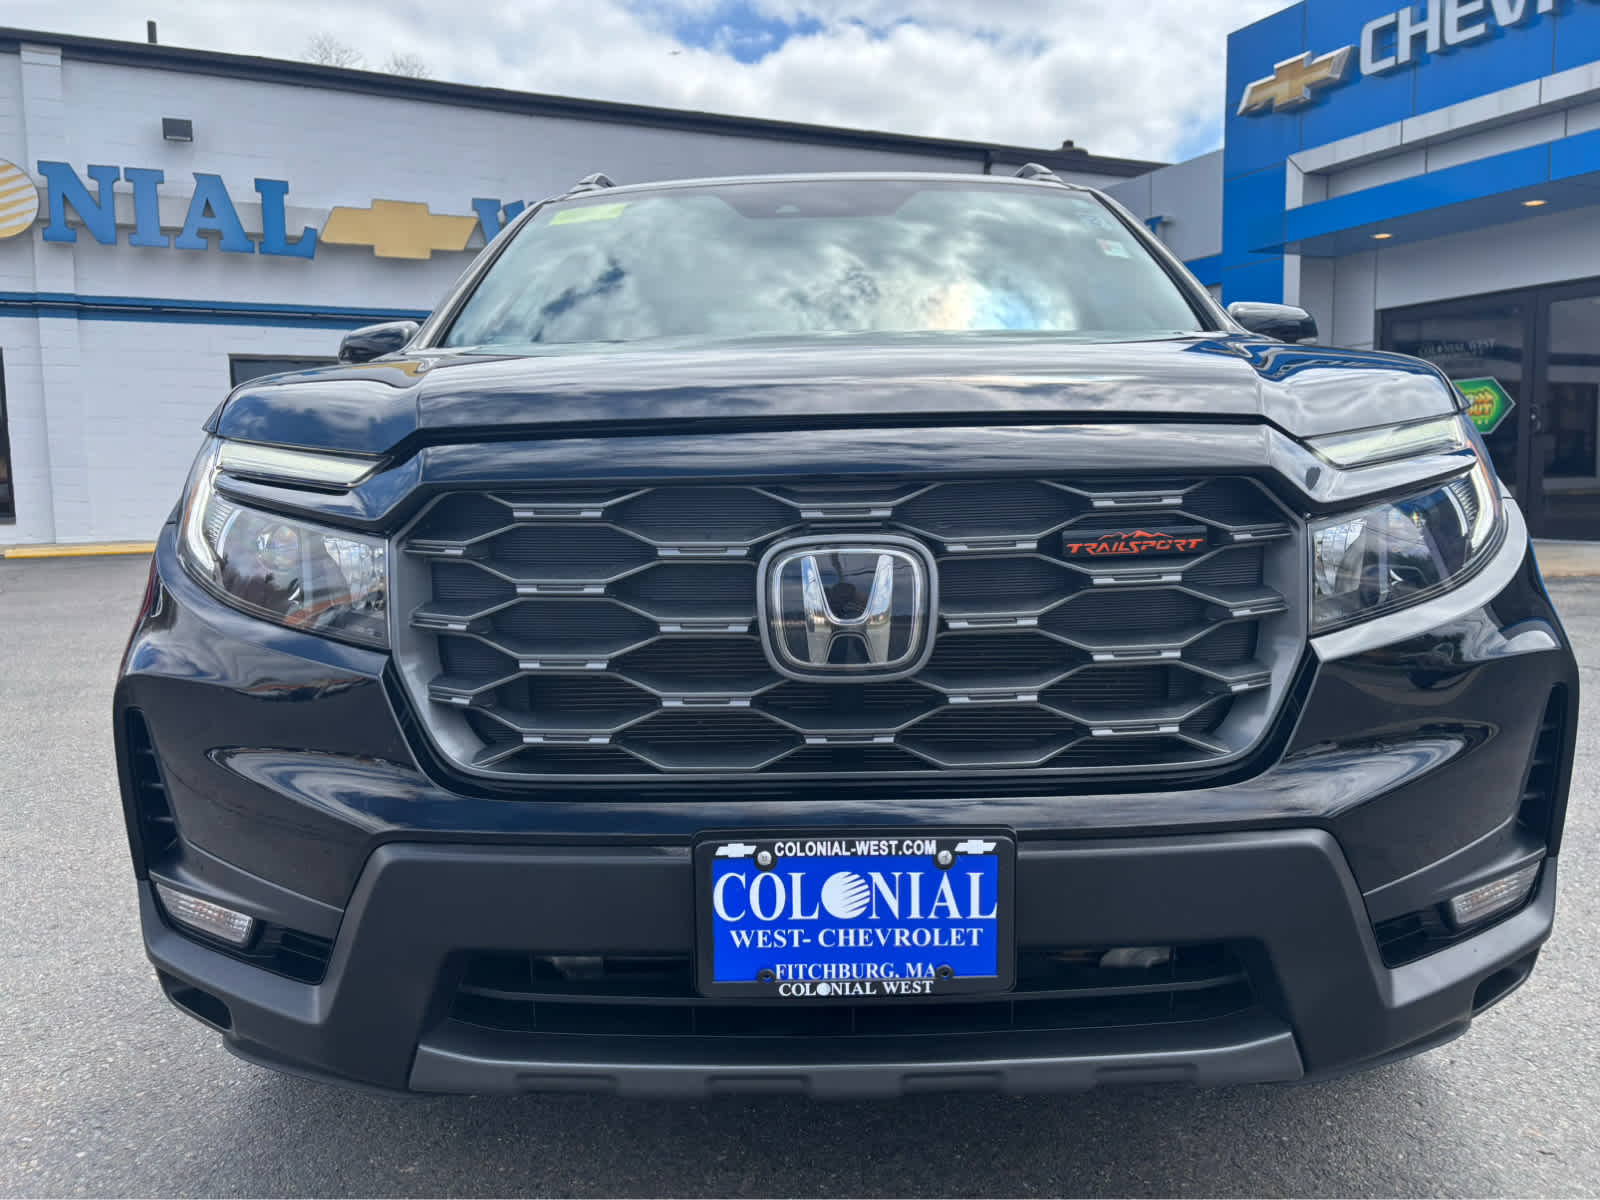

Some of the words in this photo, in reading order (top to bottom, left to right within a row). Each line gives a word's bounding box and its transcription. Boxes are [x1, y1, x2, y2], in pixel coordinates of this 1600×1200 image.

[1360, 0, 1553, 76] CHE
[1066, 538, 1204, 555] TRAILSPORT
[774, 839, 937, 857] COLONIAL-WEST.COM
[712, 871, 998, 922] COLONIAL
[730, 929, 811, 948] WEST-
[818, 927, 984, 947] CHEVROLET
[905, 962, 936, 979] MA
[778, 982, 877, 997] COLONIAL
[882, 980, 935, 995] WEST
